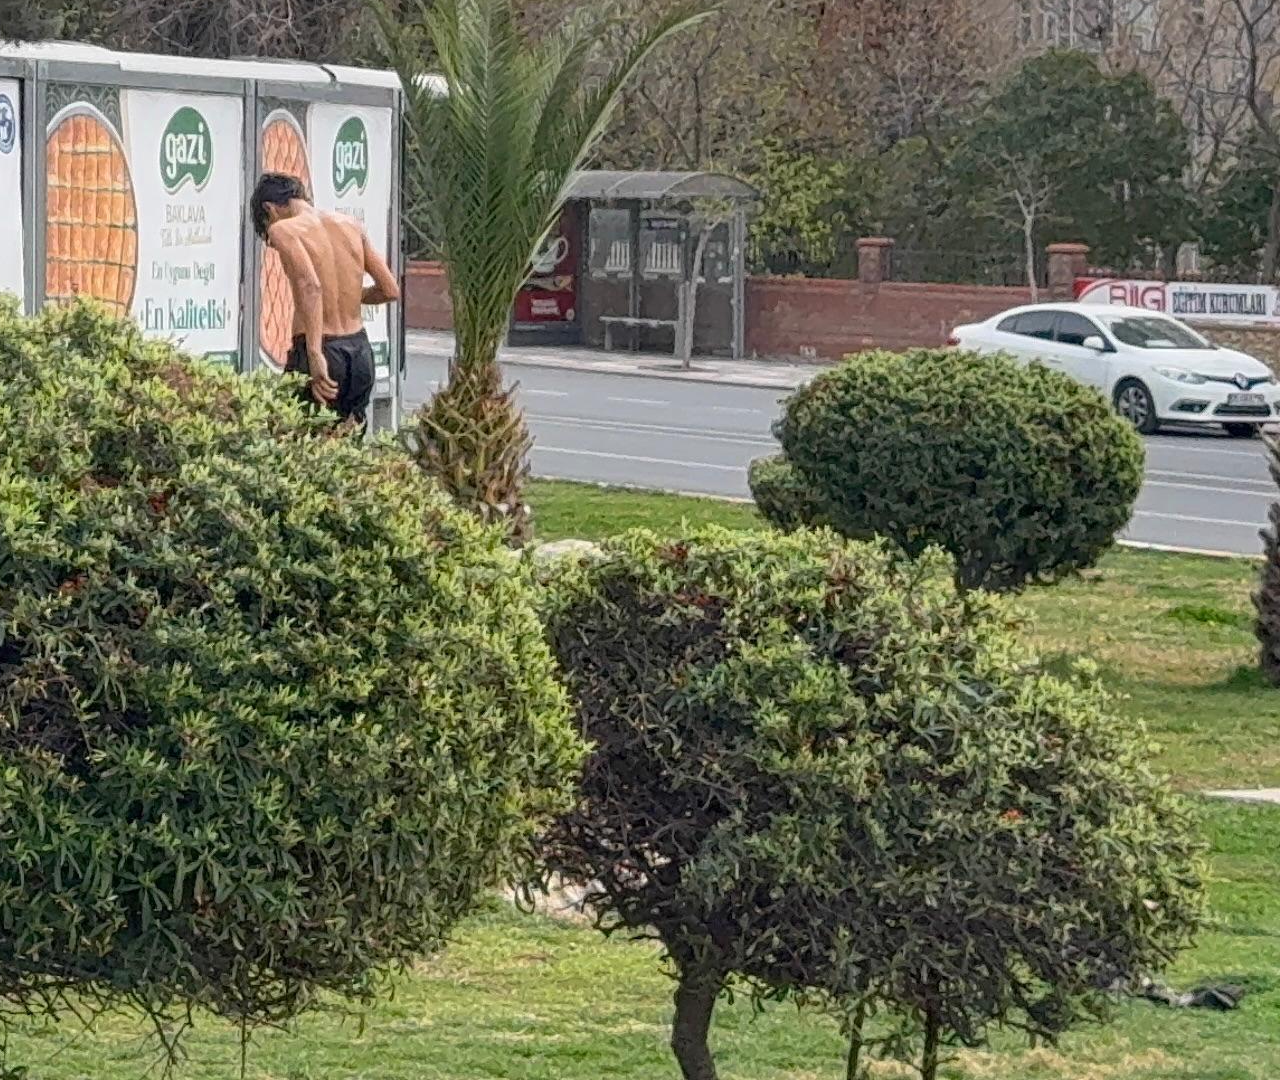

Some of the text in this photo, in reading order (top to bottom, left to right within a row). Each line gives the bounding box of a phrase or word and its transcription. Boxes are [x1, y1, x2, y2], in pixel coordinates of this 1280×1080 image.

[165, 121, 206, 179] gazi
[336, 131, 365, 183] gazi
[166, 204, 206, 224] BAKLAVA
[145, 298, 226, 330] En Kalitelisi
